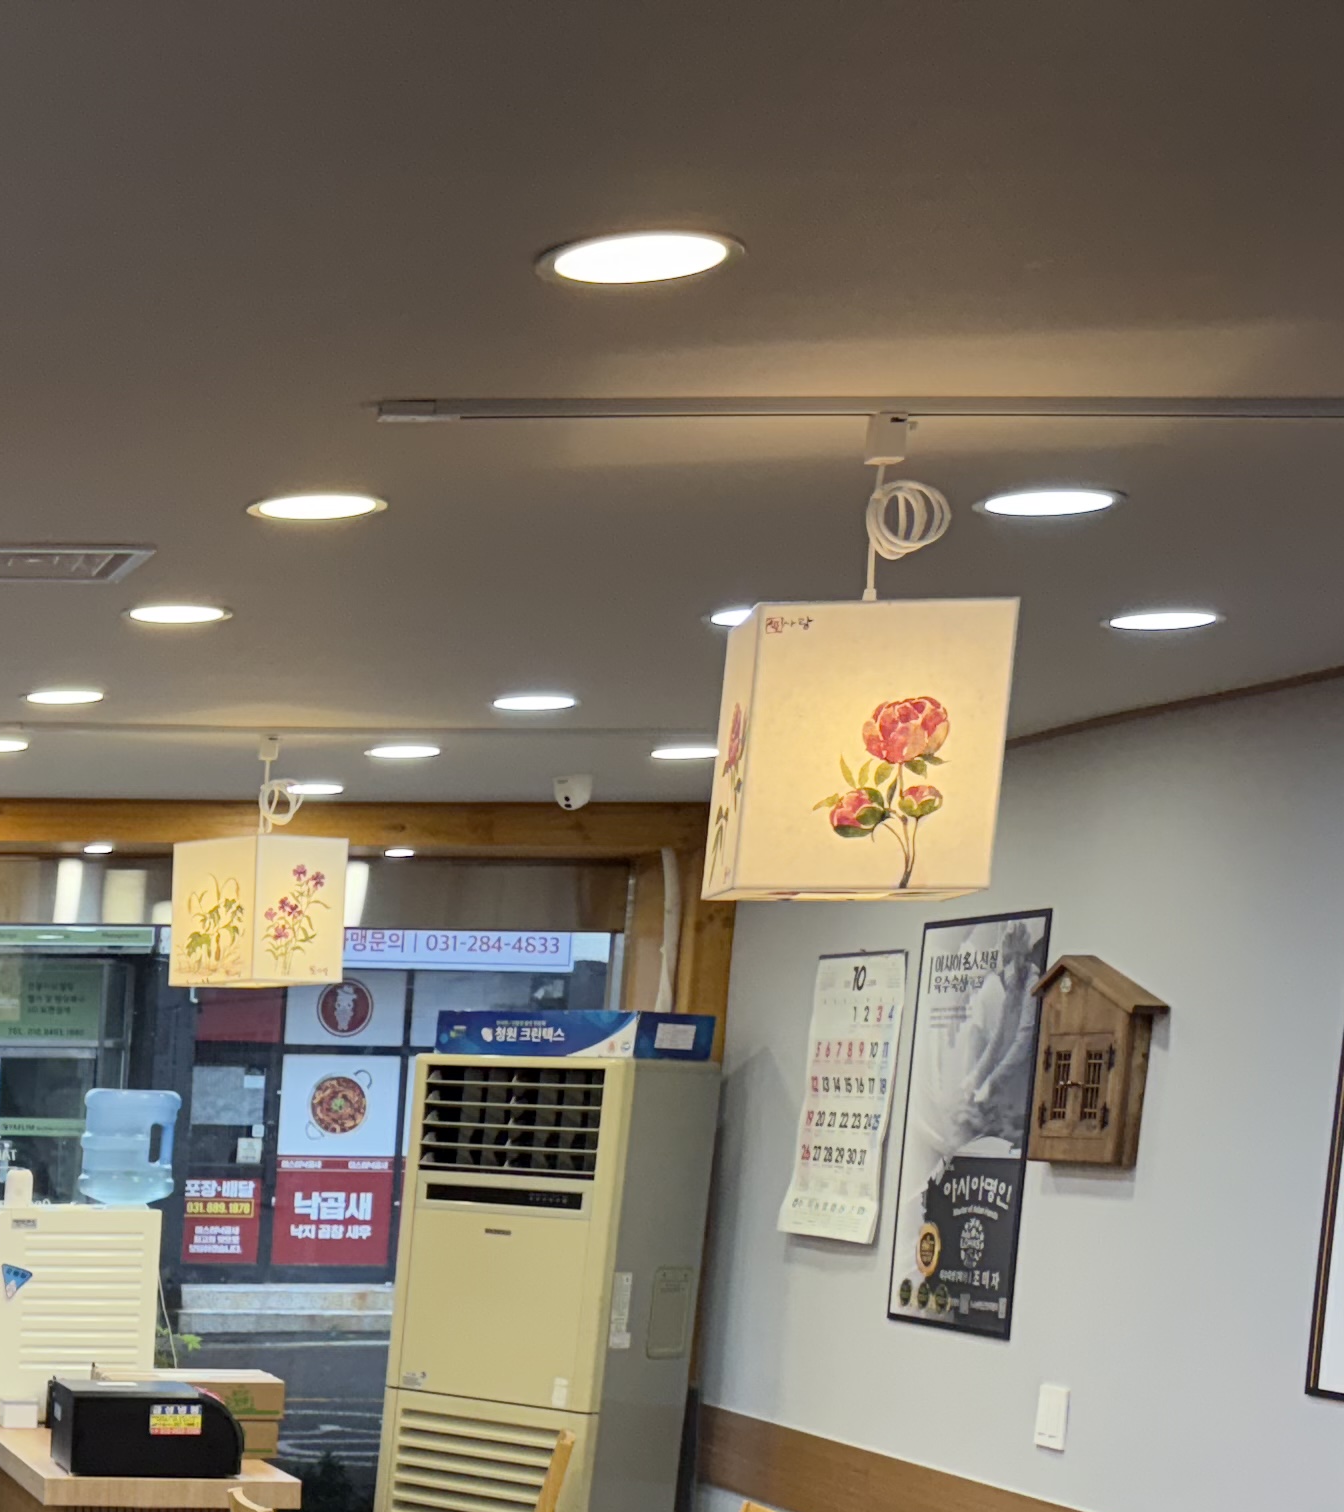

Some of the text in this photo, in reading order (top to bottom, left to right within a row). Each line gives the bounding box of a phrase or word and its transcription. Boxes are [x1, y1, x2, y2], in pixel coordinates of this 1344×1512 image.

[852, 965, 866, 991] 10
[864, 1005, 870, 1022] 2
[876, 1005, 883, 1022] 3
[494, 1026, 518, 1043] 청원
[815, 1041, 822, 1057] 5
[825, 1041, 831, 1058] 6
[836, 1041, 842, 1058] 7
[847, 1041, 853, 1058] 8
[859, 1041, 864, 1058] 9
[869, 1041, 879, 1058] 10
[811, 1076, 887, 1095] 12 13 14 15 16 17 18
[805, 1110, 881, 1131] 19 20 21 22 23 24 25
[801, 1144, 867, 1166] 26 27 28 29 30 31
[943, 1174, 1013, 1211] 아시아명인
[294, 1191, 373, 1221] 낙곱새
[290, 1224, 372, 1240] 낙지 곱창 새우
